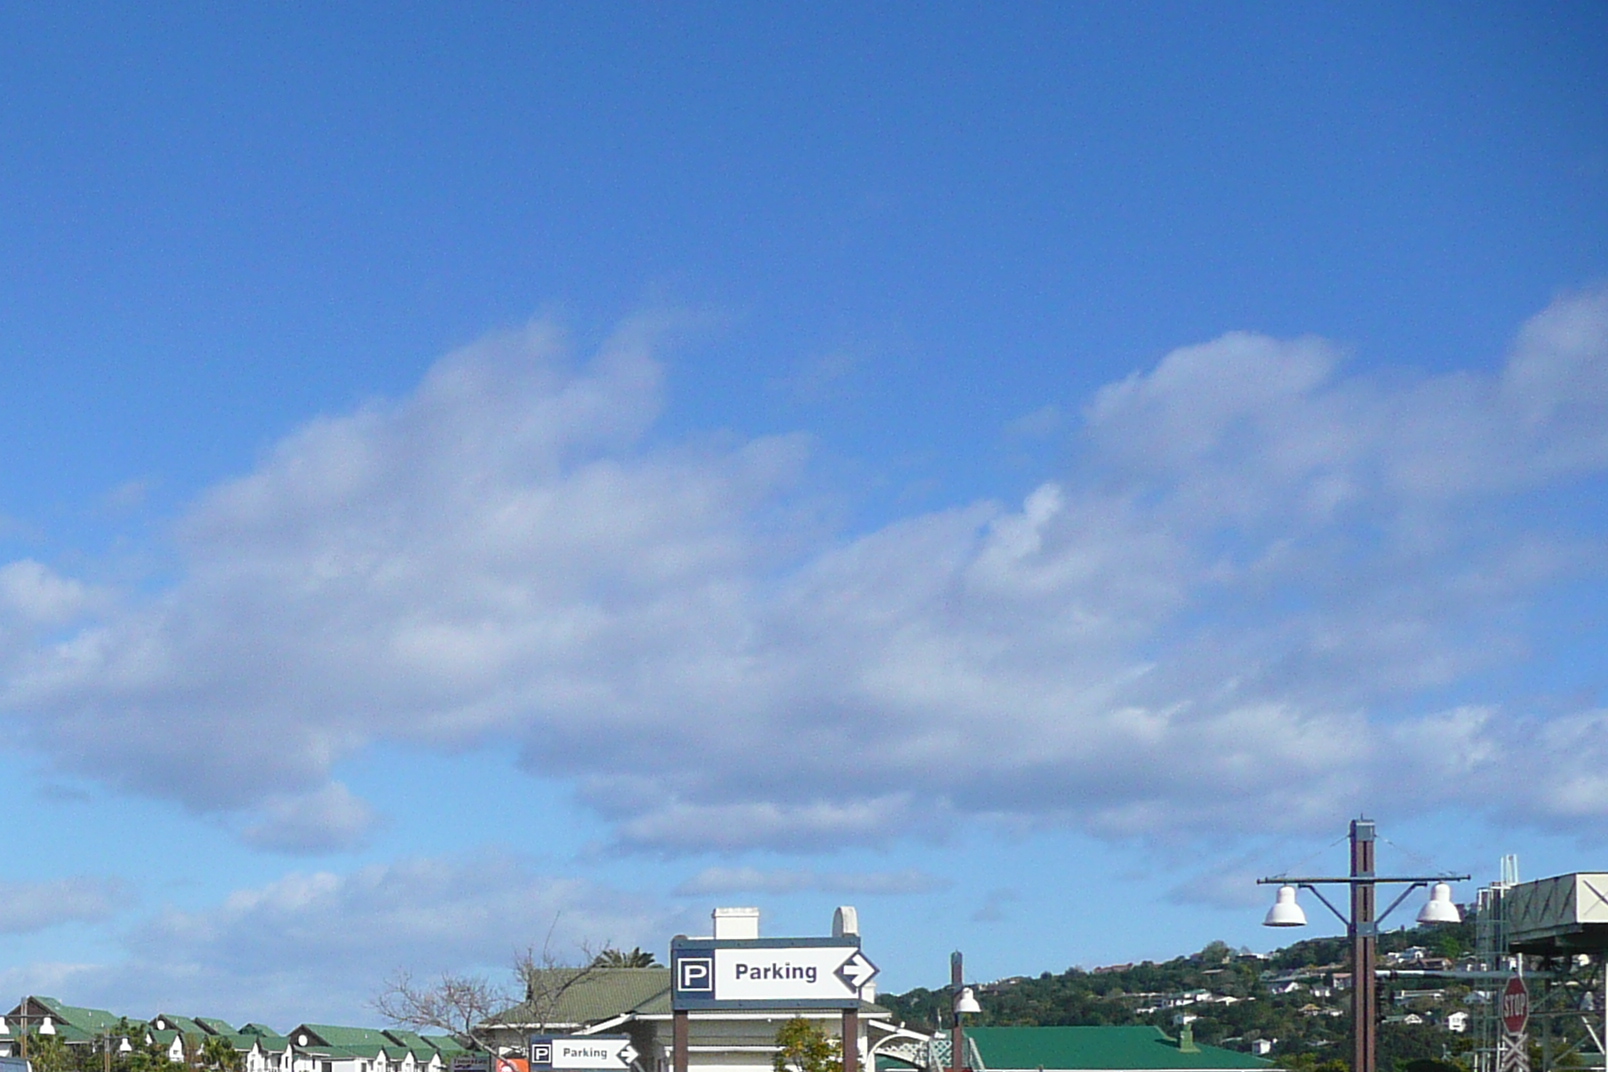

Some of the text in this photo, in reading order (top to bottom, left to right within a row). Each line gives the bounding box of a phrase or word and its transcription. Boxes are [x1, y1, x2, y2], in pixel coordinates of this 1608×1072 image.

[684, 961, 817, 987] P Parking
[1504, 993, 1526, 1018] STOP
[535, 1048, 607, 1060] P Parking
